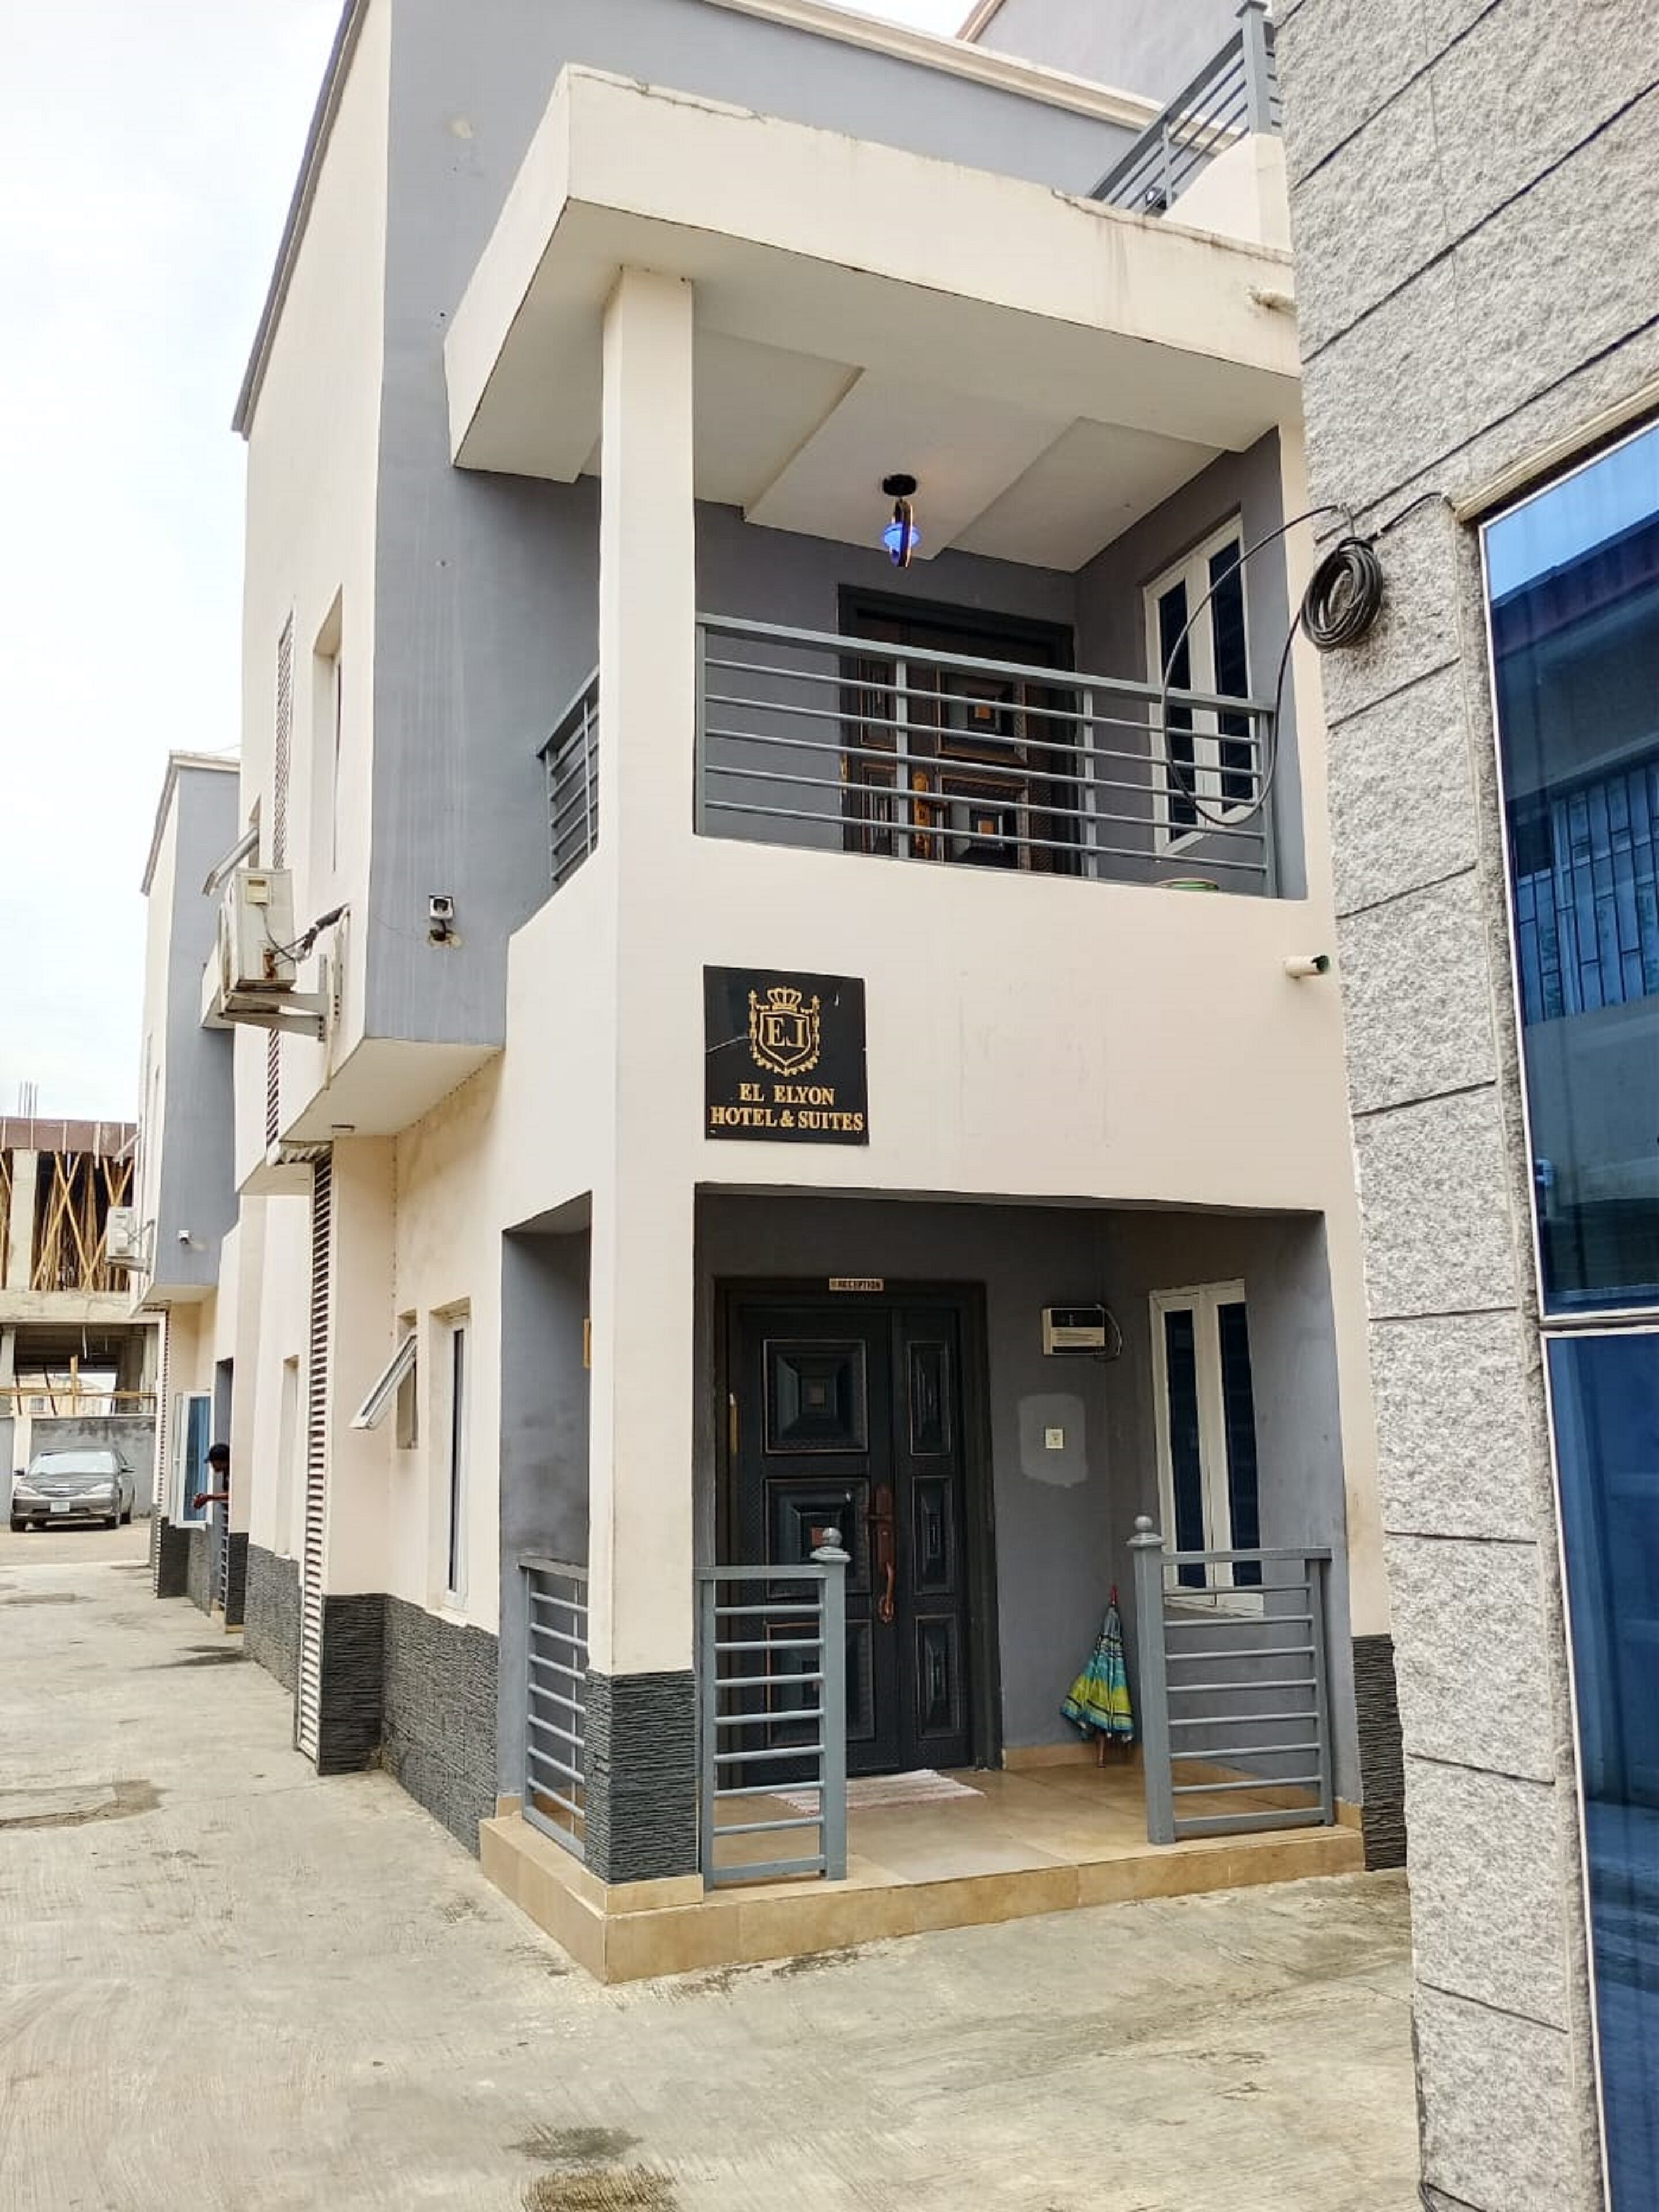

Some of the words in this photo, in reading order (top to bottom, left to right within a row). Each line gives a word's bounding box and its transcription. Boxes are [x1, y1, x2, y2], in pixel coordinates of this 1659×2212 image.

[738, 1083, 764, 1102] EL
[774, 1085, 835, 1106] ELYON
[710, 1105, 778, 1127] HOTEL
[779, 1109, 796, 1128] &
[798, 1111, 863, 1131] SUITES
[838, 1279, 881, 1290] RECEPTION
